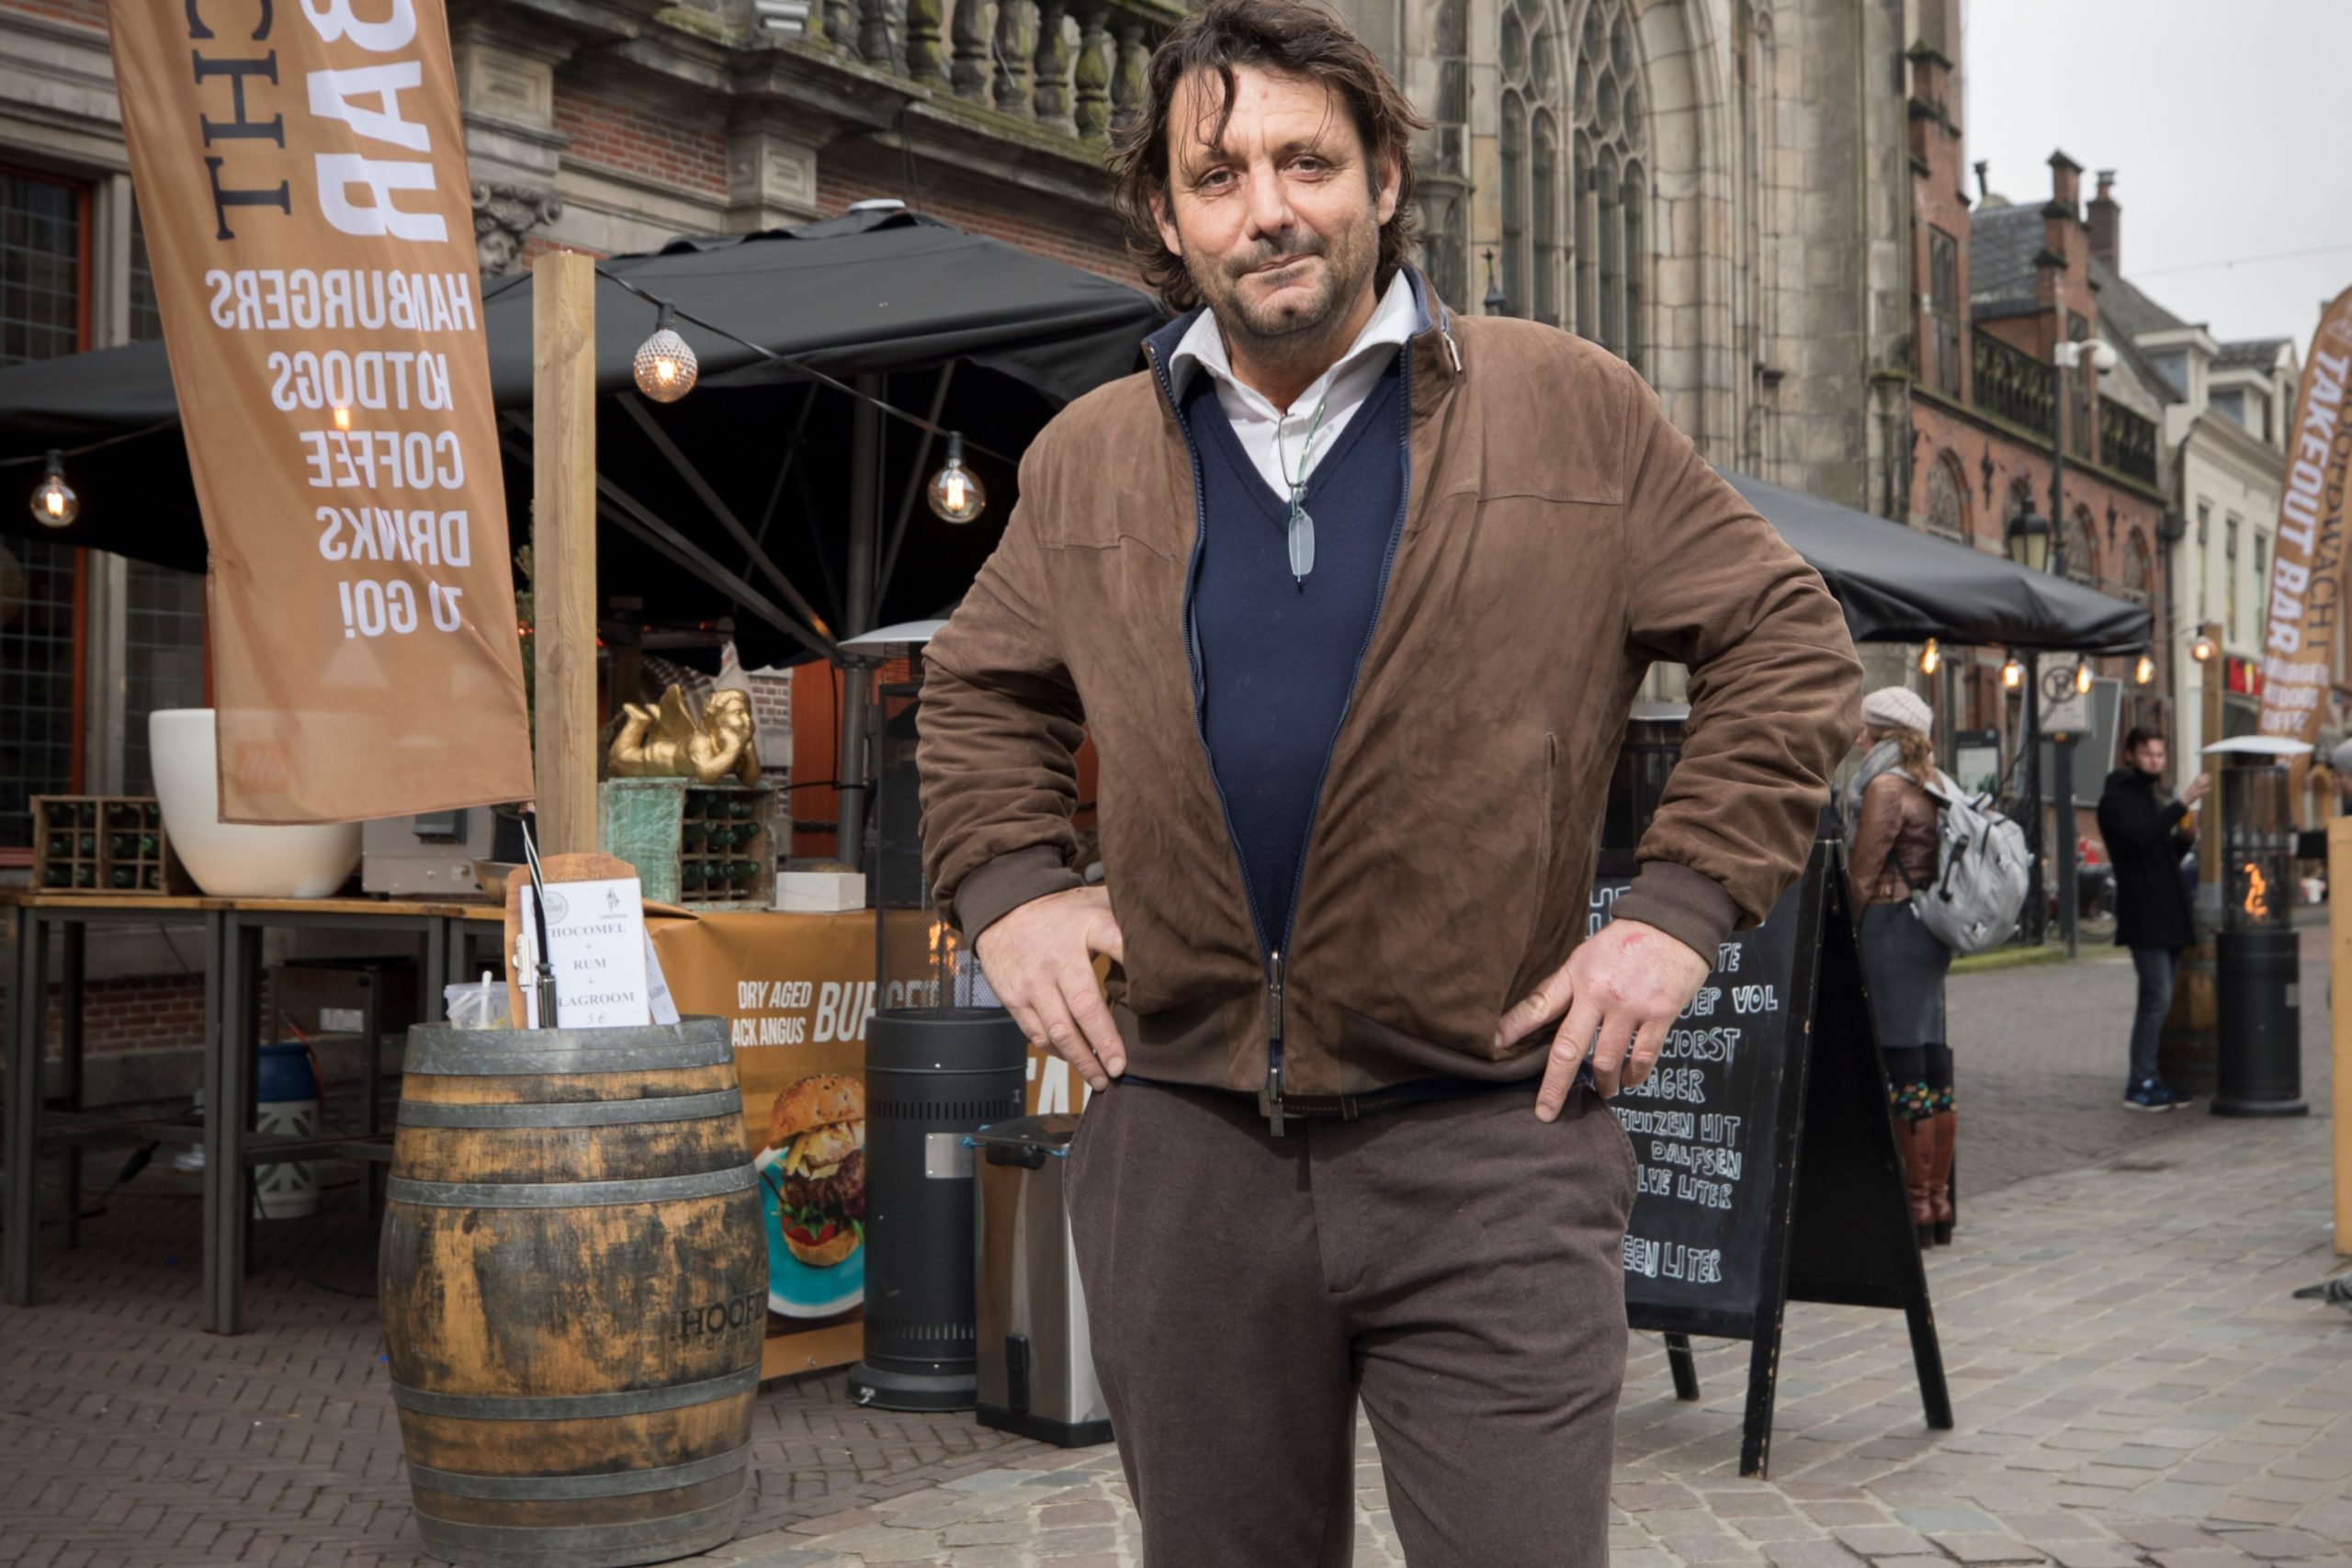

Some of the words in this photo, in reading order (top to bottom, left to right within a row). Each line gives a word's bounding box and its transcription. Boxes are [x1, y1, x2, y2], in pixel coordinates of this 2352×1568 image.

[2278, 350, 2349, 558] TAKEOUT
[2267, 557, 2310, 654] BAR
[550, 923, 627, 939] HOCOMEL
[572, 958, 606, 970] RUM
[1709, 942, 1743, 974] TE
[559, 991, 636, 1008] LAGROOM
[738, 981, 768, 1009] DRY
[768, 981, 812, 1009] AGED
[1732, 984, 1779, 1014] VOL
[731, 1020, 760, 1047] ACK
[760, 1017, 807, 1045] ANGUS
[1611, 1107, 1694, 1139] HUIZEN
[1651, 1141, 1742, 1180] DALFSEN
[1637, 1164, 1673, 1195] LVE
[1677, 1174, 1733, 1210] LITER
[1661, 1242, 1722, 1284] LITER
